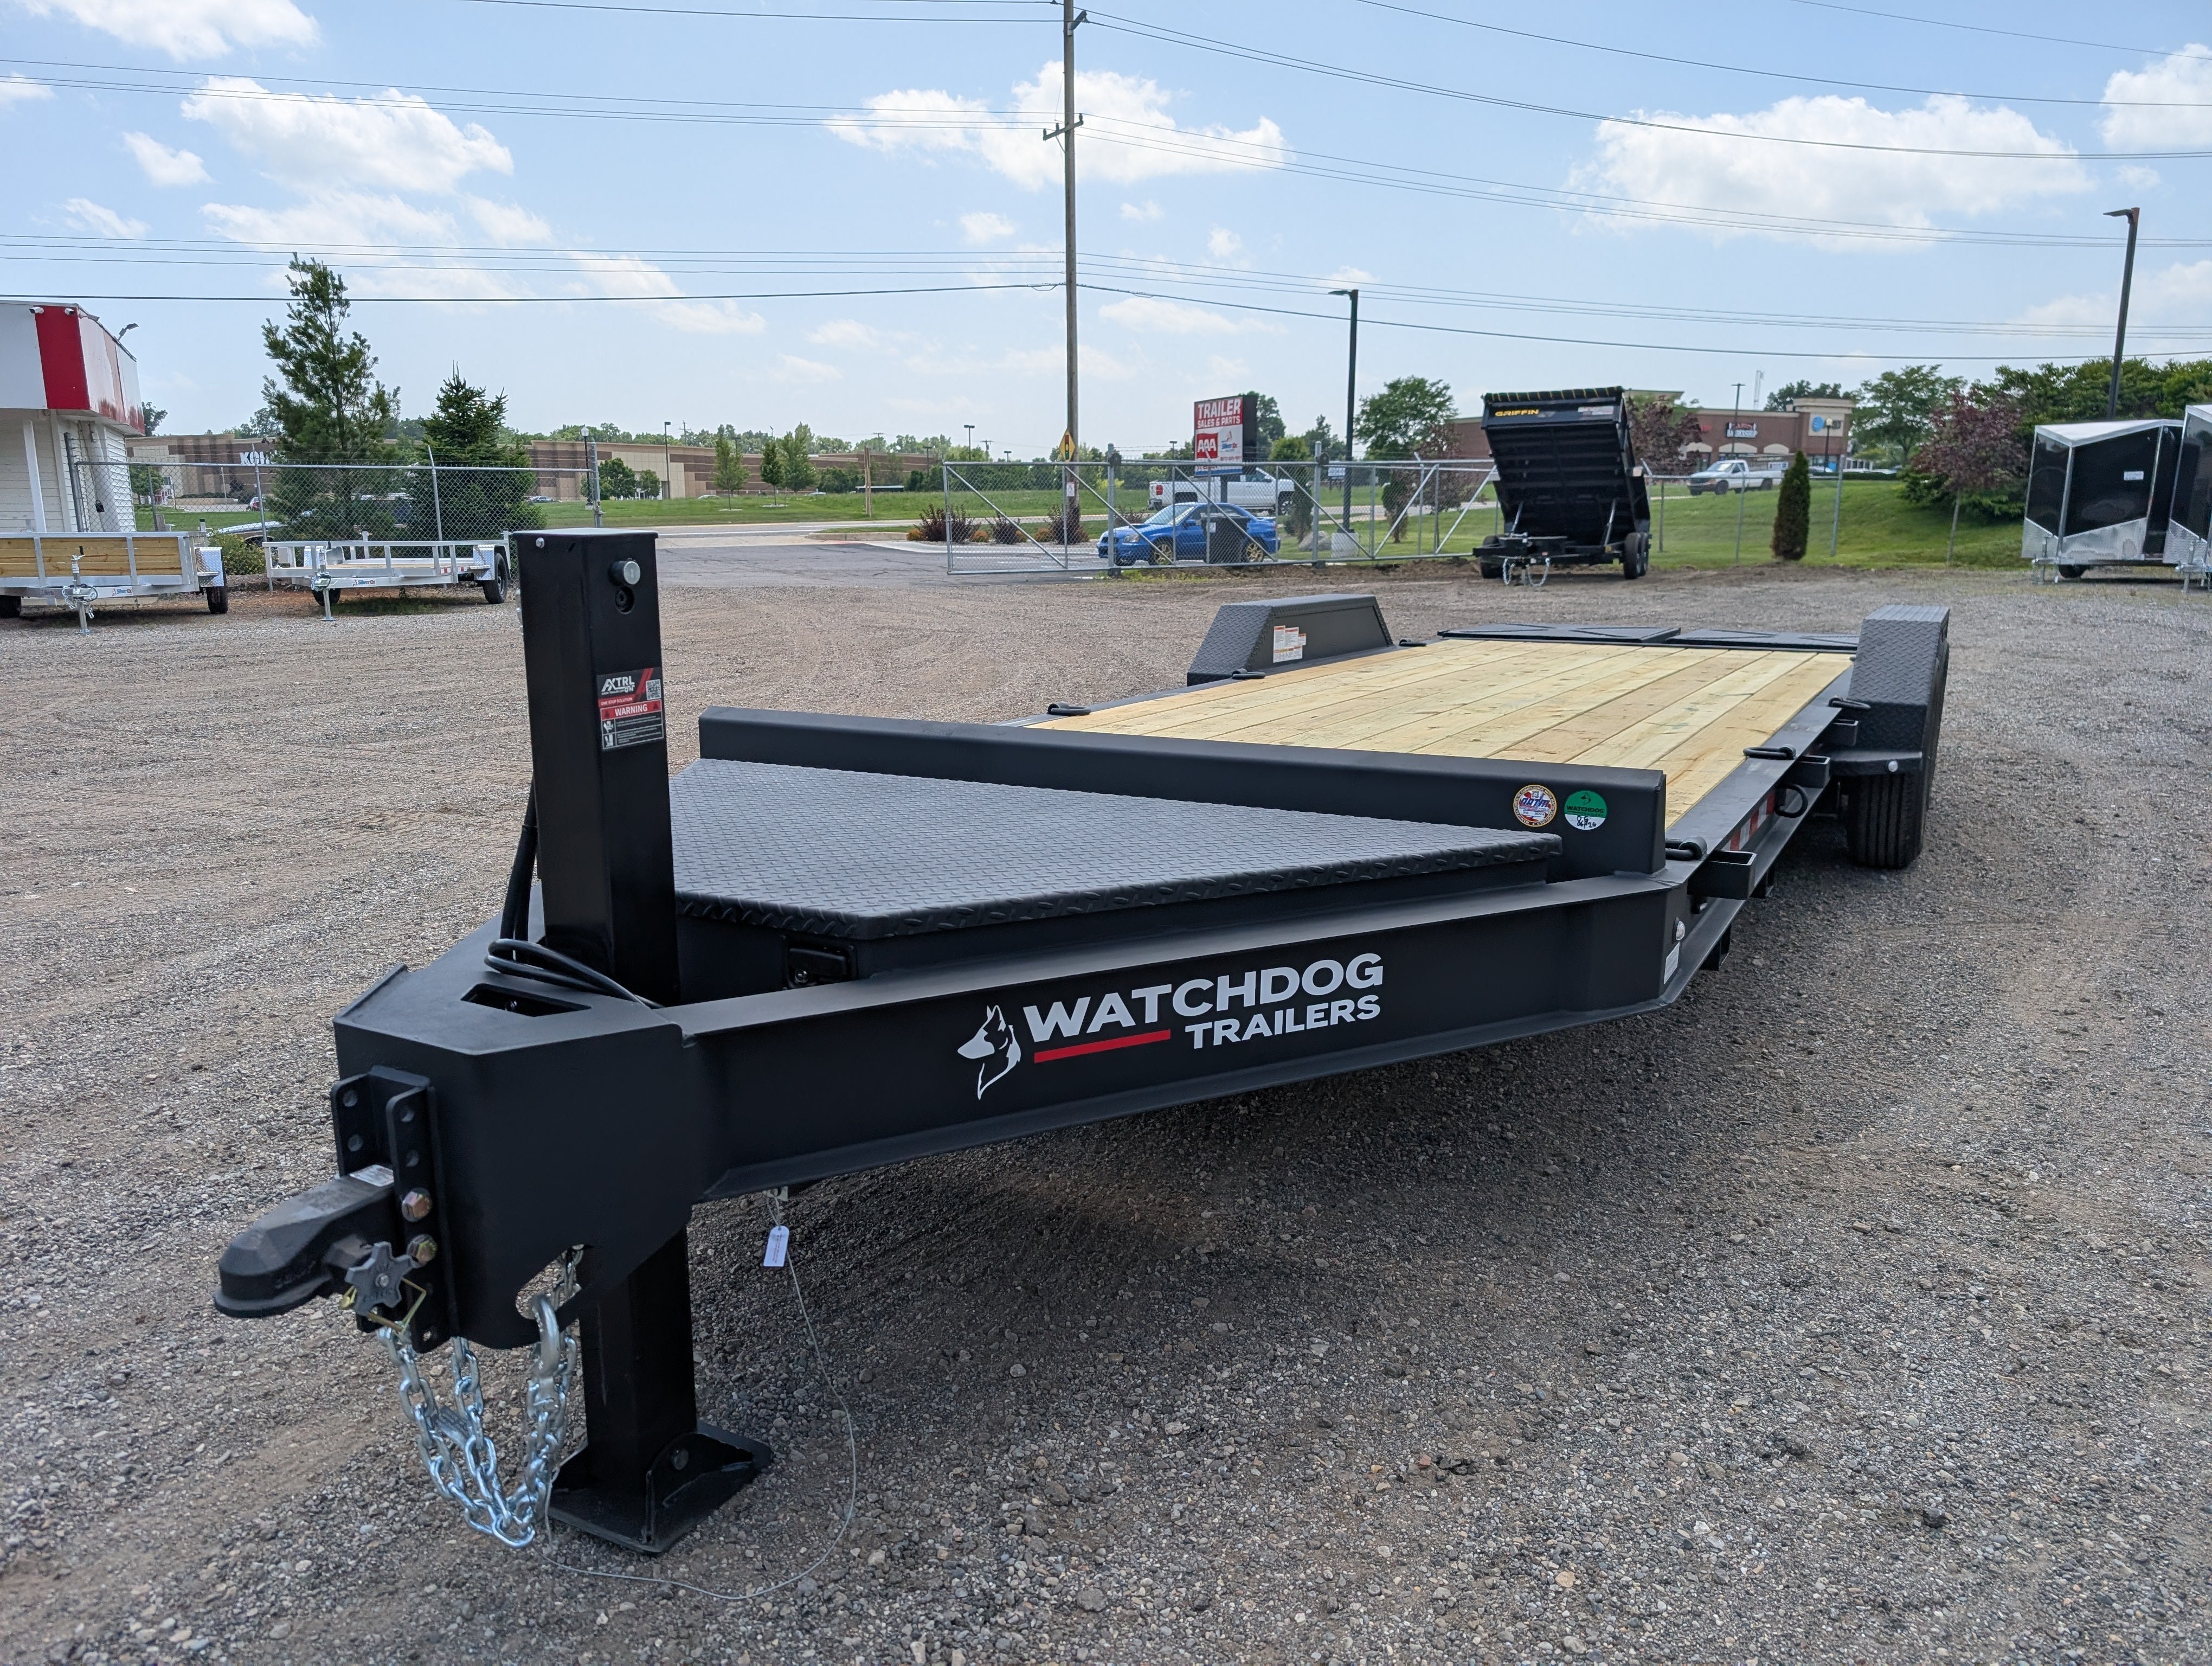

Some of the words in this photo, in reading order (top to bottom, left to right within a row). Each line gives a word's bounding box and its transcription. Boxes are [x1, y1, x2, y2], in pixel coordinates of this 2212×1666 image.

[1198, 399, 1241, 419] TRAILER
[1494, 409, 1540, 417] GRIFFIN
[1197, 419, 1214, 428] SALES
[1221, 415, 1241, 426] PARTS
[1197, 439, 1217, 452] AAA
[615, 704, 648, 716] WARNING
[1023, 953, 1384, 1043] WATCHDOG
[1186, 995, 1381, 1049] TRAILERS
